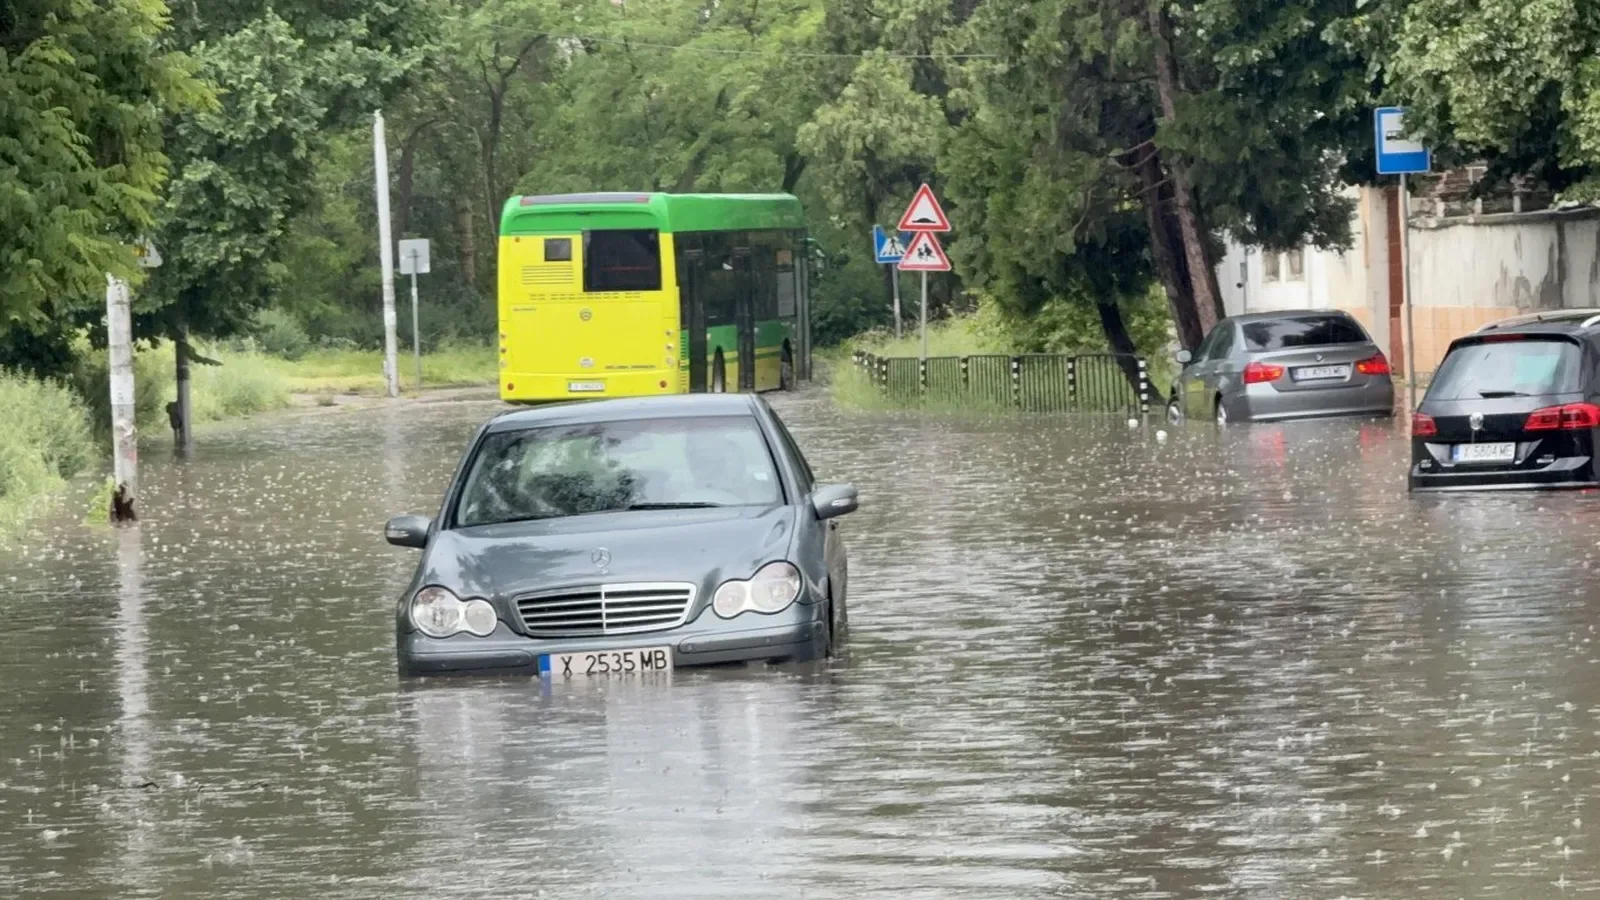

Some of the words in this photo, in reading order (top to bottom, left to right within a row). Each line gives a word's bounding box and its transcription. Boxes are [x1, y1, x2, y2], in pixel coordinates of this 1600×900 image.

[560, 655, 573, 674] X
[585, 651, 636, 674] 2535
[640, 649, 668, 670] MB
